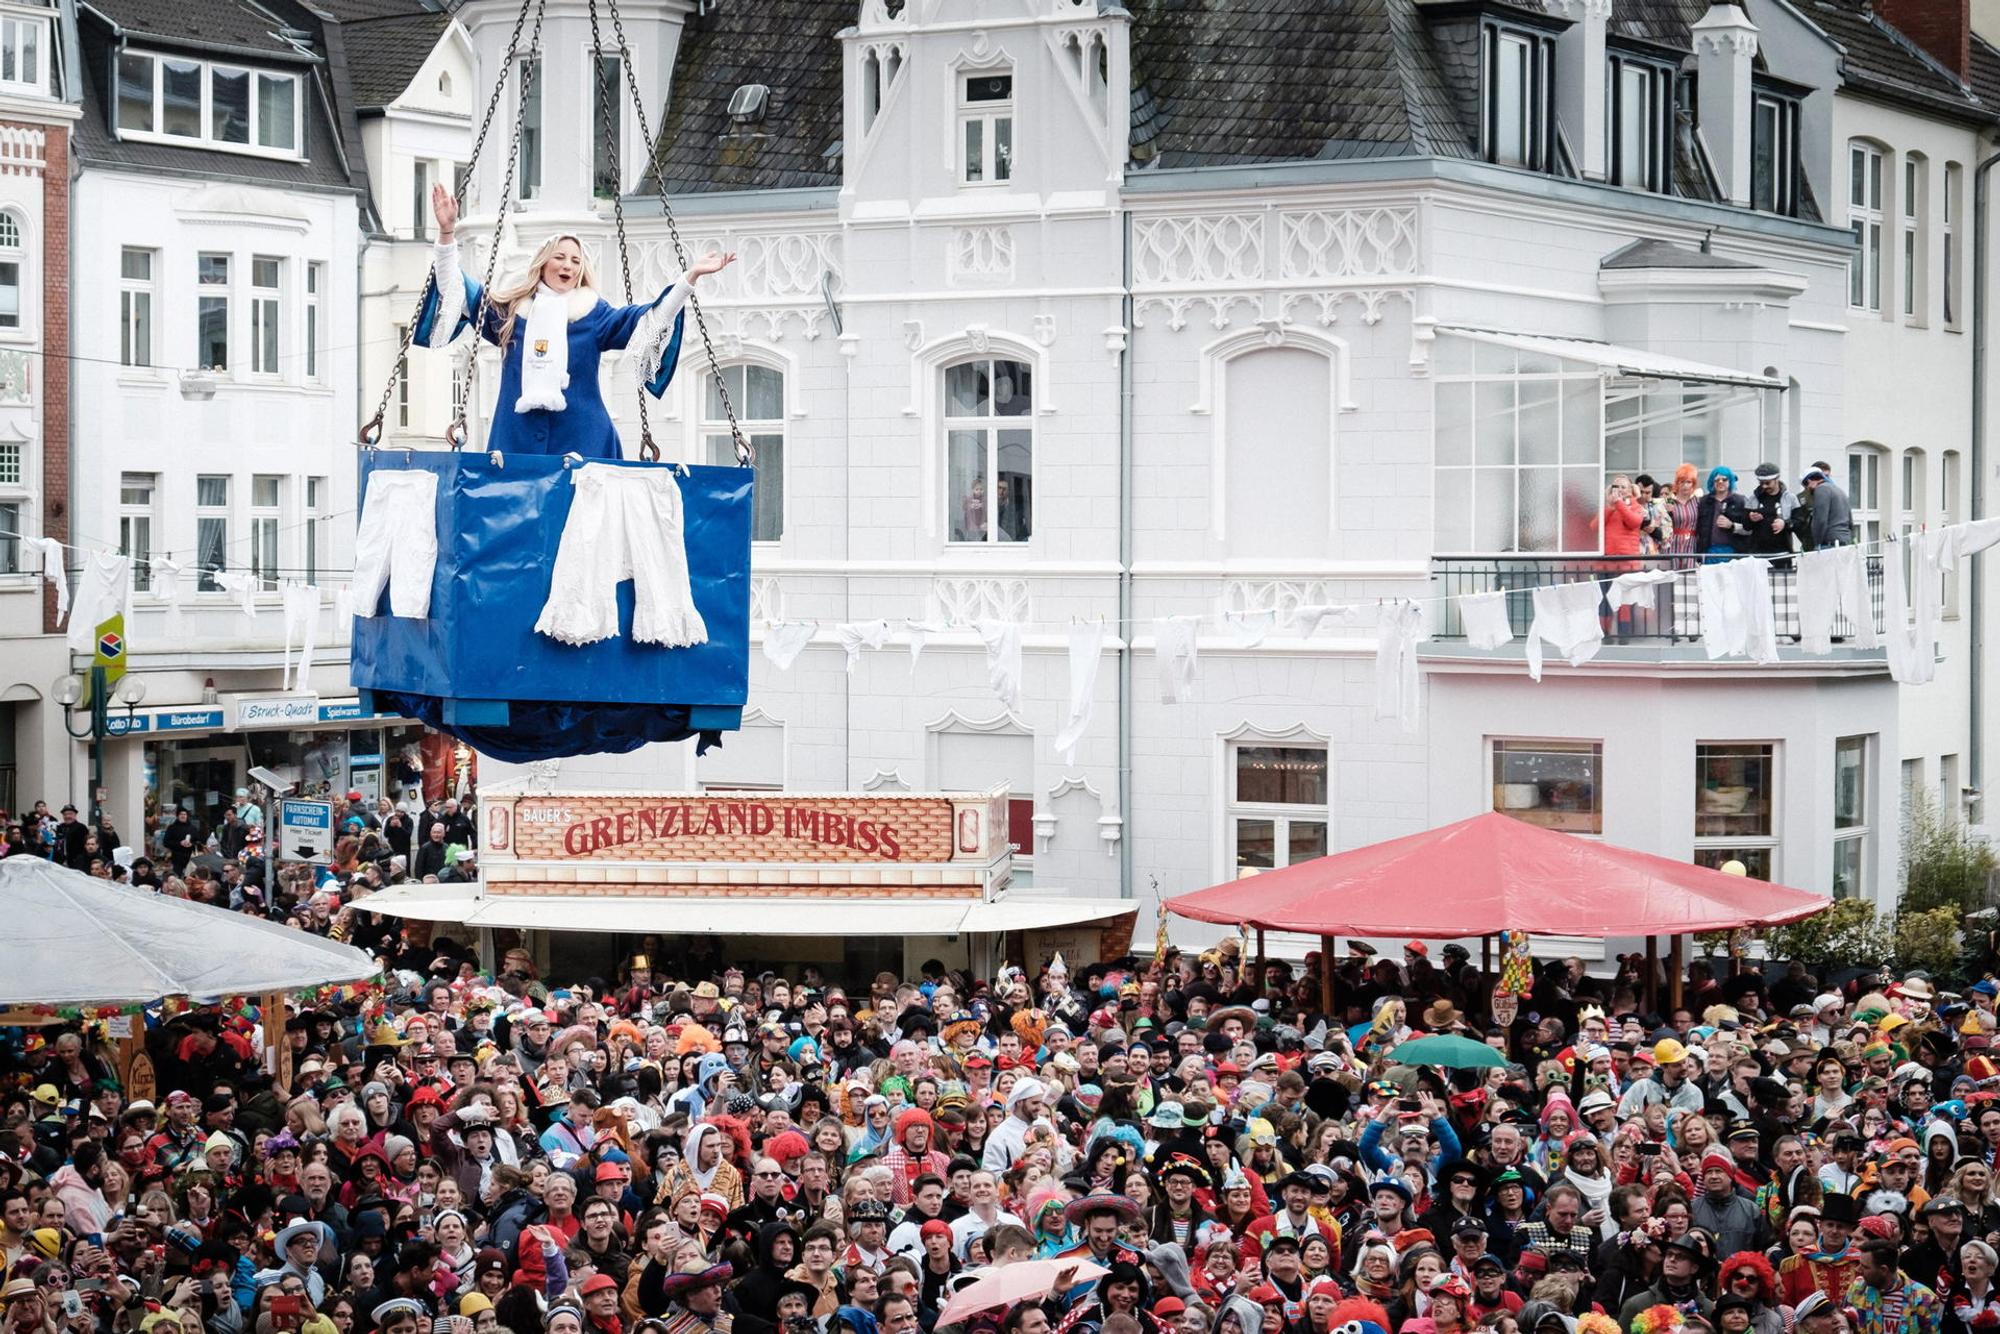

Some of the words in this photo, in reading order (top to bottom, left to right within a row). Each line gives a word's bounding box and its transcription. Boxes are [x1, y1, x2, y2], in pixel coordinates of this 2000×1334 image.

[171, 712, 210, 726] Bürobedarf
[327, 706, 360, 719] Spielwaren
[126, 717, 141, 729] Tto
[286, 804, 326, 816] PARKSCHEIN-
[523, 808, 572, 823] BAUER'S
[292, 815, 320, 826] AUTOMAT
[564, 803, 775, 856] GRENZLAND
[783, 806, 900, 860] IMBISS
